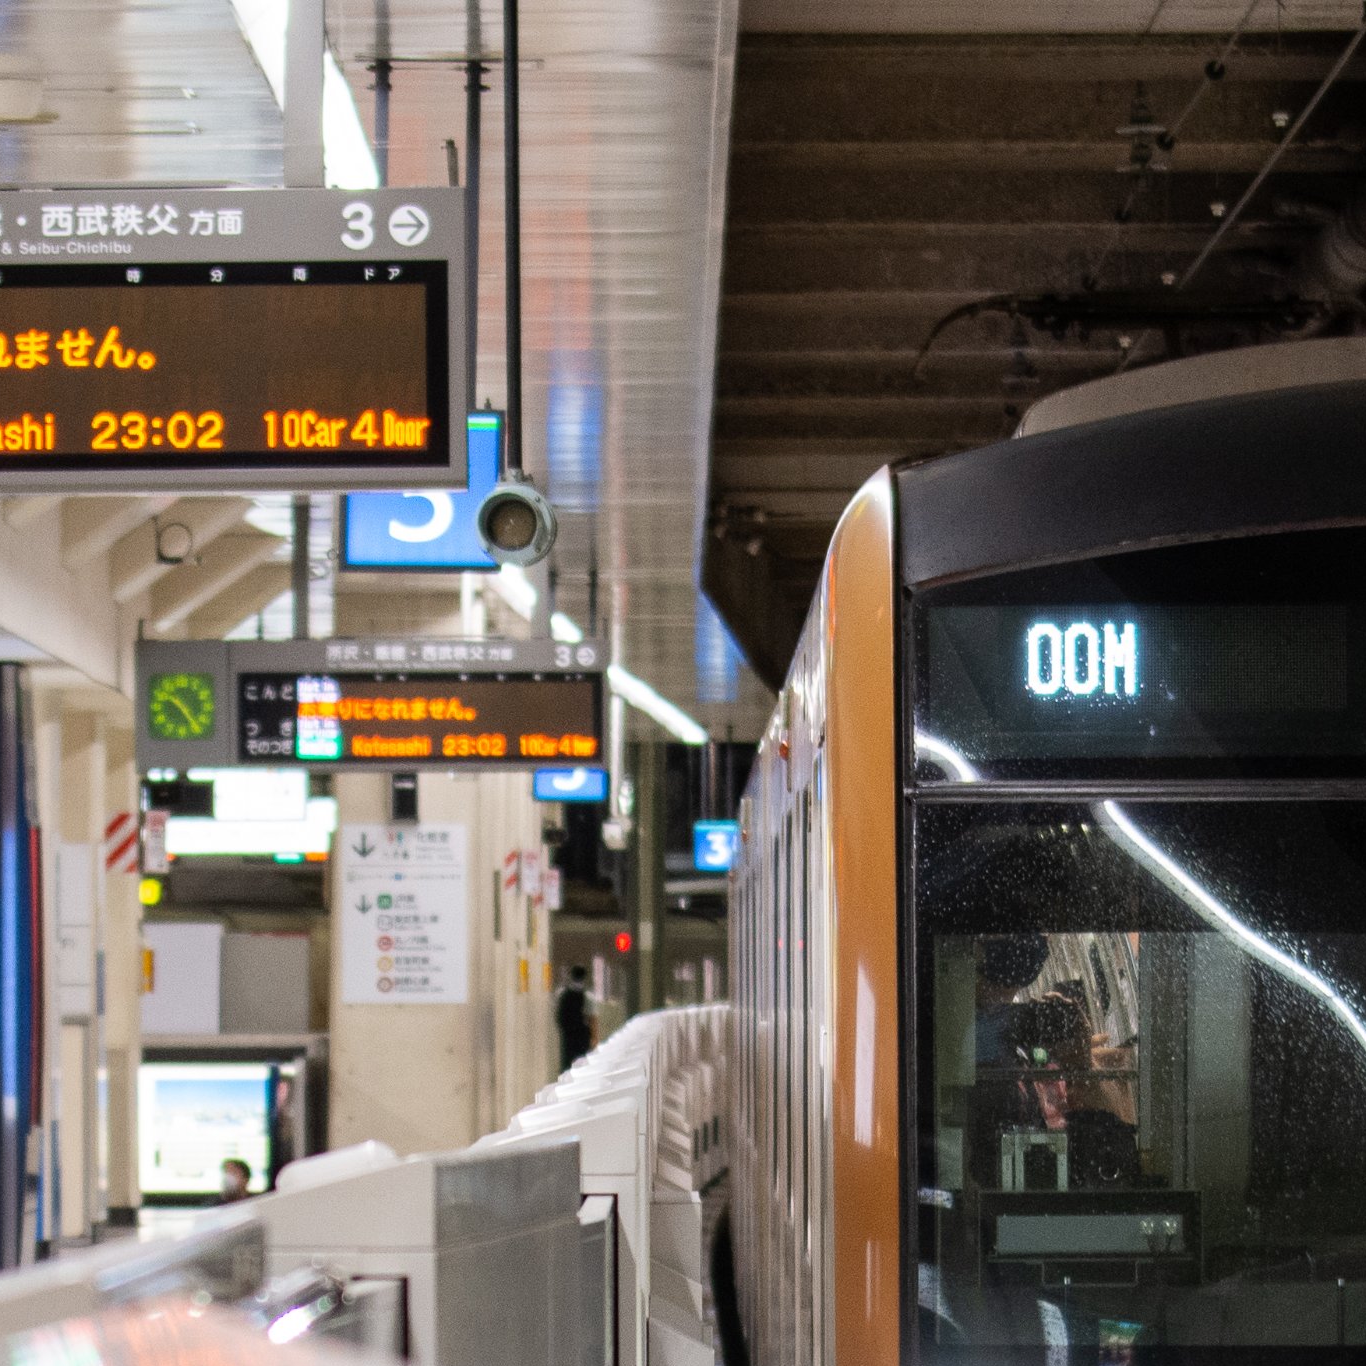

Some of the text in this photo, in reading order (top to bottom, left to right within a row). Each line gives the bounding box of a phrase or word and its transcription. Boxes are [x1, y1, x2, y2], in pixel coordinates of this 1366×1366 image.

[189, 208, 243, 236] 方面
[341, 202, 374, 250] 3
[20, 240, 132, 255] Seibu-Chichibu
[91, 412, 225, 450] 23:02
[555, 646, 571, 668] 3
[442, 734, 507, 757] 23:02
[705, 832, 731, 866] 3
